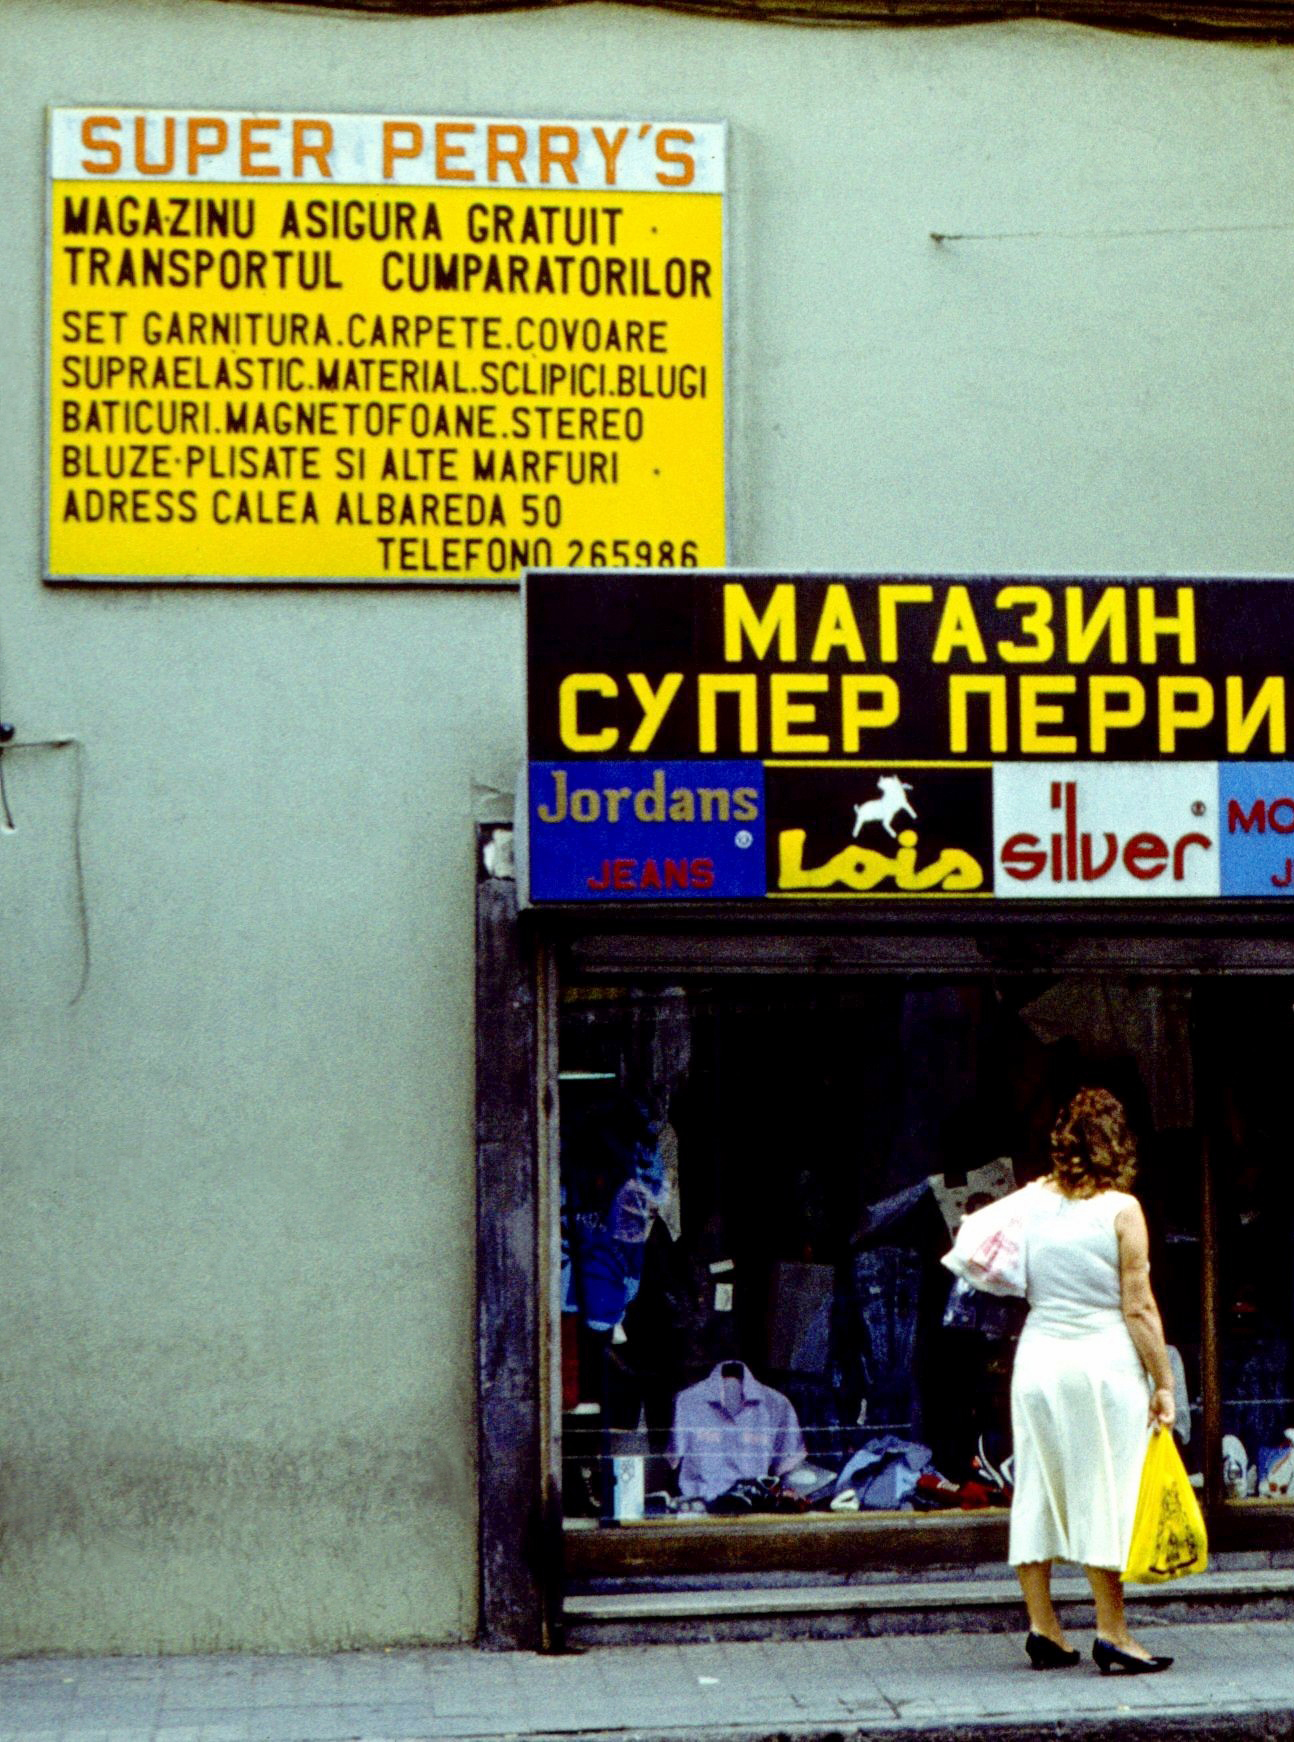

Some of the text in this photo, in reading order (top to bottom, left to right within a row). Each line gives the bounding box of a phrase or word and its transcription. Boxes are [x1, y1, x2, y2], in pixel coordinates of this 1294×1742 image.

[81, 116, 695, 187] SUPER PERRY'S
[281, 200, 441, 241] ASIGURA
[468, 203, 623, 245] GRATUIT
[63, 247, 712, 298] TRANSPORTUL CUMPARATORILOR
[62, 310, 127, 344] SET
[336, 448, 365, 480] SI
[381, 448, 457, 482] ALTE
[473, 449, 618, 485] MARFURI
[63, 489, 561, 528] ADRESS CALEA ALBAREDA 50
[378, 537, 551, 572] TELEFONO
[723, 583, 1198, 664] МАГАЗИН
[558, 673, 900, 754] СУПЕР
[537, 770, 758, 823] Jordans
[1001, 781, 1212, 882] silver
[587, 858, 715, 890] JEANS
[778, 829, 984, 890] Lois
